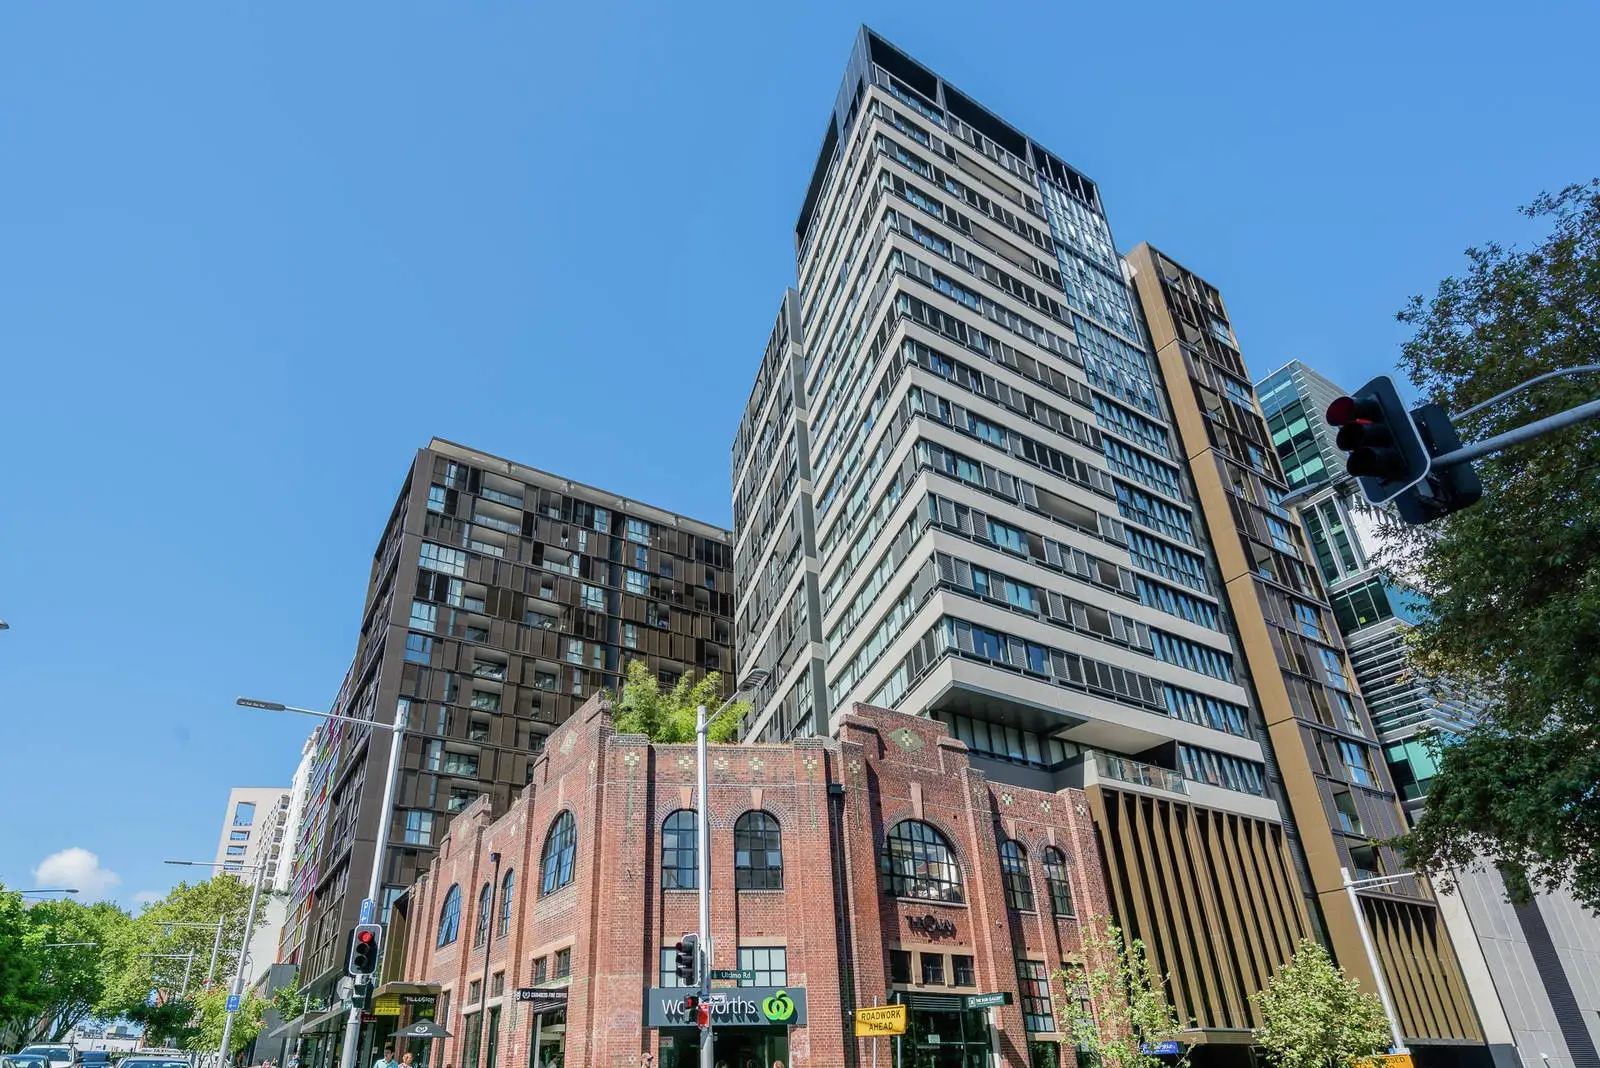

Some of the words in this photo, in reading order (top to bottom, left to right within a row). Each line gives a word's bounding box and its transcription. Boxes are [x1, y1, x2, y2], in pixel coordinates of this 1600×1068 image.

[721, 971, 741, 979] Ultimo
[743, 971, 751, 979] Rd
[861, 1009, 901, 1021] ROADWORK
[869, 1022, 893, 1031] AHEAD
